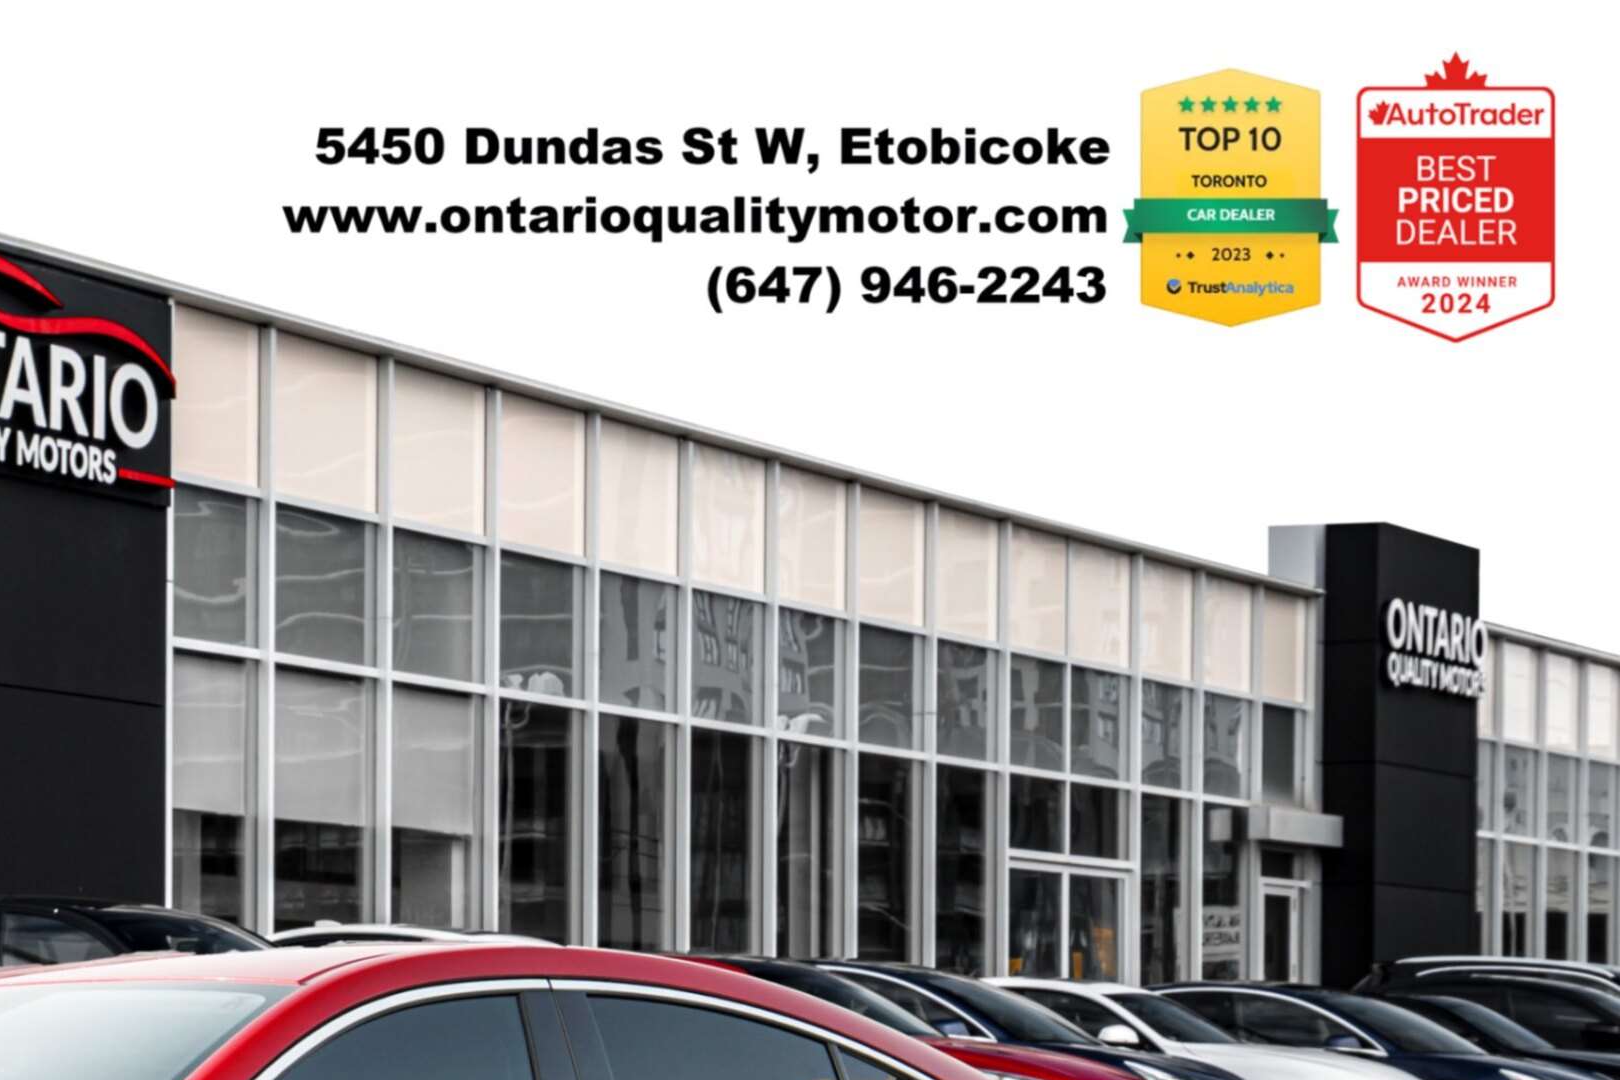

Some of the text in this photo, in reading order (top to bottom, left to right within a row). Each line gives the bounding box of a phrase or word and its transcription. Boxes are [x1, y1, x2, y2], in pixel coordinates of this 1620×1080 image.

[16, 430, 118, 484] MOTORS
[1387, 597, 1488, 667] ONTARIO
[1387, 652, 1440, 689] QUALITY
